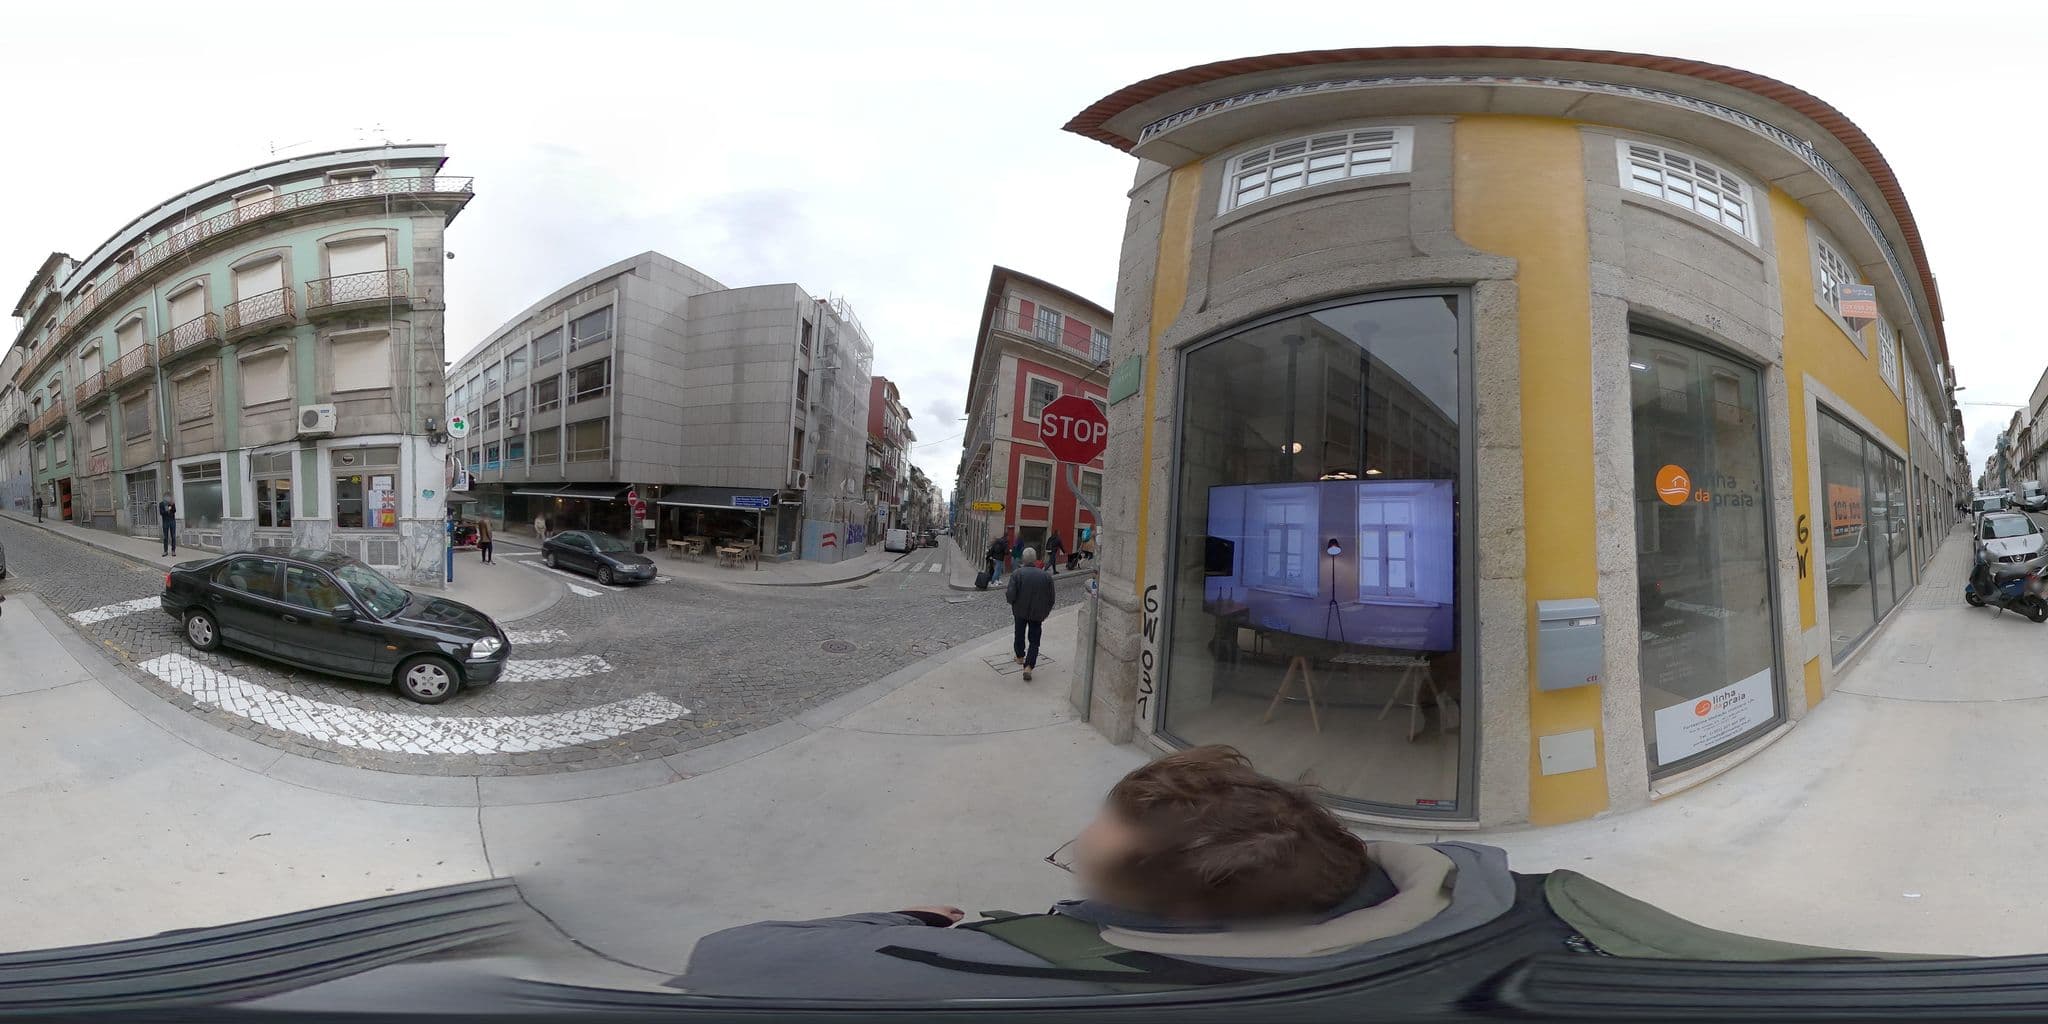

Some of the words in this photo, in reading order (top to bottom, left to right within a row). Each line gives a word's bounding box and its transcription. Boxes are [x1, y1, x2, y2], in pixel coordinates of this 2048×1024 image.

[1042, 413, 1107, 444] STOP
[1694, 487, 1711, 503] da
[1713, 489, 1754, 511] praia
[1713, 690, 1736, 704] linha
[1723, 693, 1746, 709] praia
